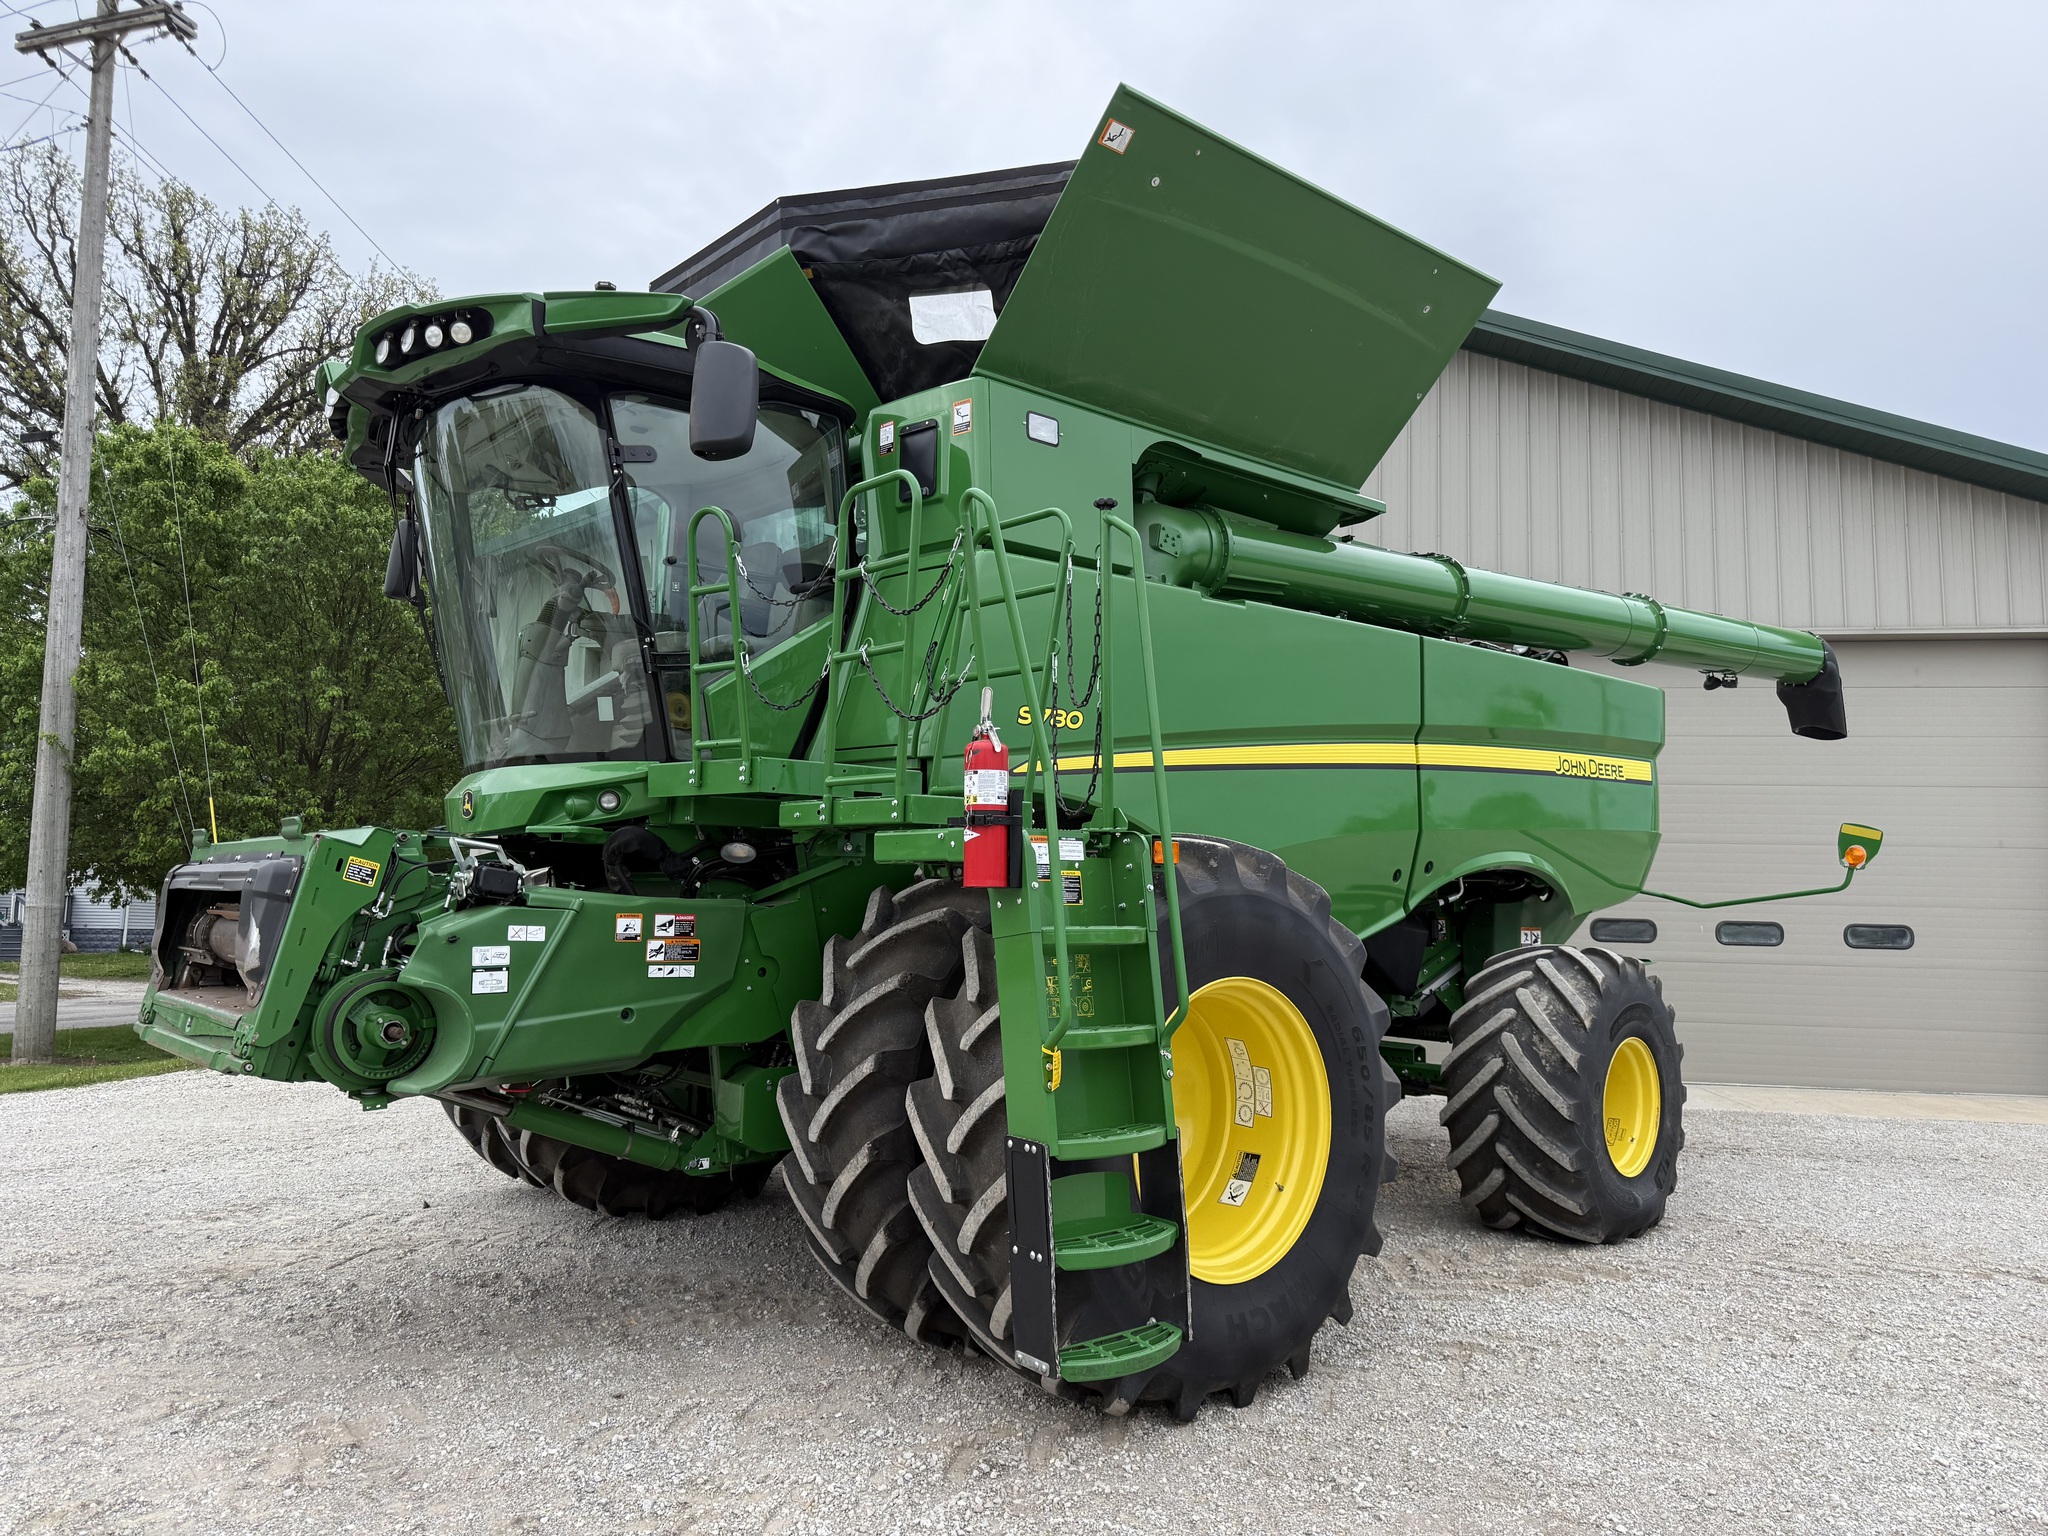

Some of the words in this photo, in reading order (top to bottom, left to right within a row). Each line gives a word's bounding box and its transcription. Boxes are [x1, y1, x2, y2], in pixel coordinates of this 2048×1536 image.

[1556, 755, 1587, 775] JOHN
[1588, 759, 1625, 778] DEERE
[355, 859, 379, 868] CAUTION
[1351, 1025, 1375, 1143] 650/85
[1233, 1151, 1243, 1174] CAUTION
